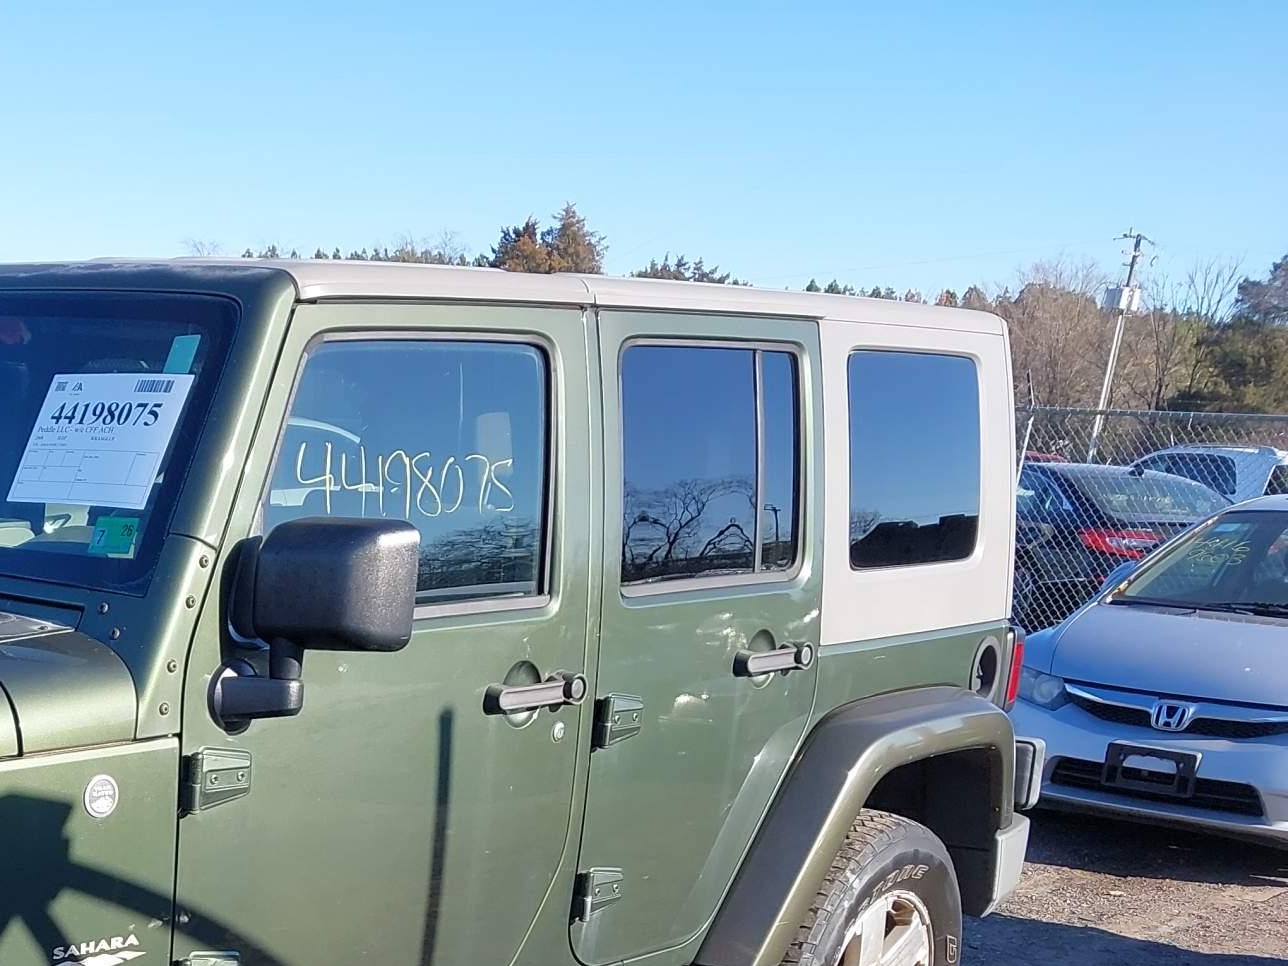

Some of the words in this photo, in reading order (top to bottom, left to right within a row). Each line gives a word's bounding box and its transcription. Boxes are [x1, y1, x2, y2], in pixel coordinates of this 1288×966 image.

[51, 402, 163, 426] 44198075
[296, 442, 513, 519] 44198075
[97, 529, 106, 545] 7
[120, 524, 135, 537] 26
[53, 934, 140, 960] SAHARA
